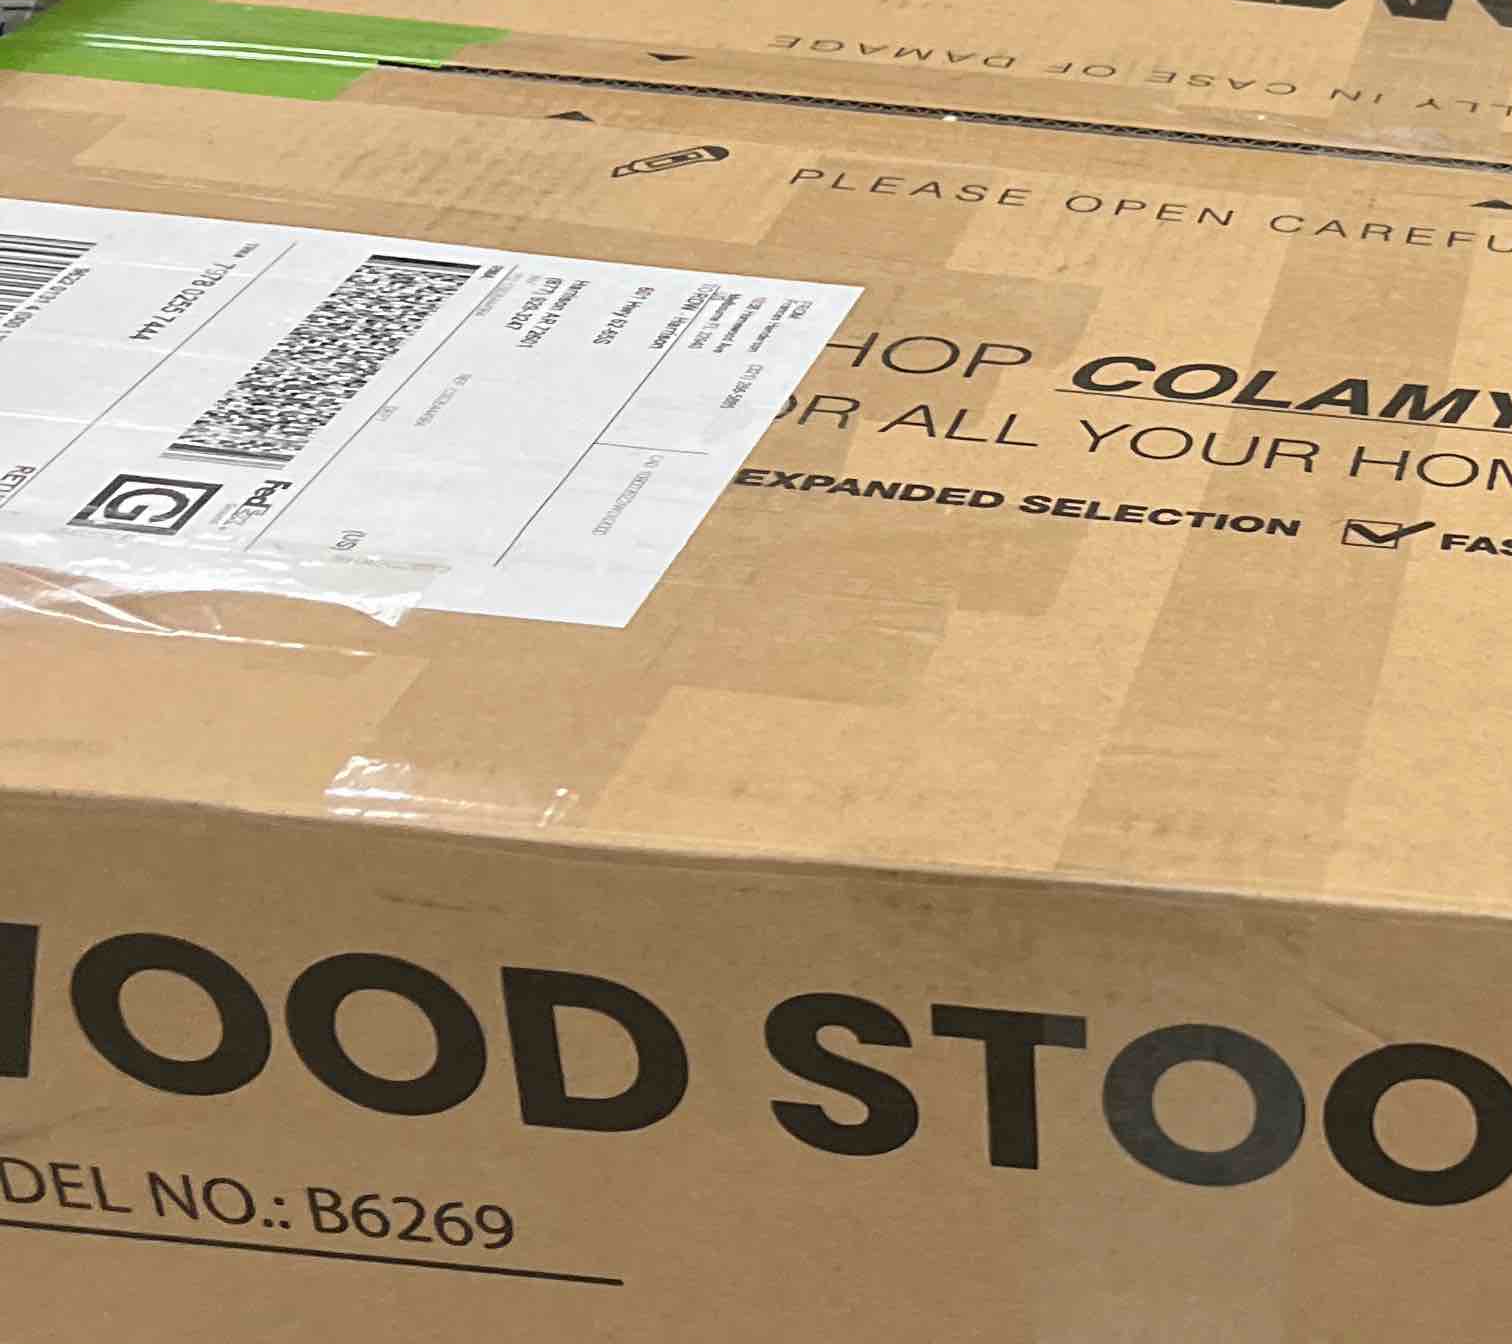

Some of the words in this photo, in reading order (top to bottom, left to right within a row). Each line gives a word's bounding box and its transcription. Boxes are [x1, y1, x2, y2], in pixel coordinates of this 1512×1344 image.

[767, 34, 1016, 69] DAMAGE
[1042, 62, 1117, 77] OF
[1146, 71, 1298, 95] CASE
[1330, 88, 1383, 104] IN
[790, 169, 1029, 206] PLEASE
[1066, 196, 1233, 225] OPEN
[189, 262, 238, 286] 7978
[536, 277, 564, 295] (877)
[158, 288, 207, 314] 0255
[550, 280, 590, 310] Harrison
[503, 297, 548, 330] 929-3247
[538, 312, 562, 324] AR
[610, 300, 643, 318] Hwy
[127, 315, 178, 340] 7444
[516, 326, 550, 348] 72601
[648, 316, 688, 349] Harrison
[878, 405, 1037, 446] ALL
[1080, 420, 1319, 472] YOUR
[104, 488, 190, 522] G
[734, 469, 1004, 508] EXPANDED
[1019, 496, 1300, 536] SELECTION
[329, 529, 368, 551] (US)
[149, 1171, 289, 1230] NO.:
[307, 1186, 514, 1248] B6269
